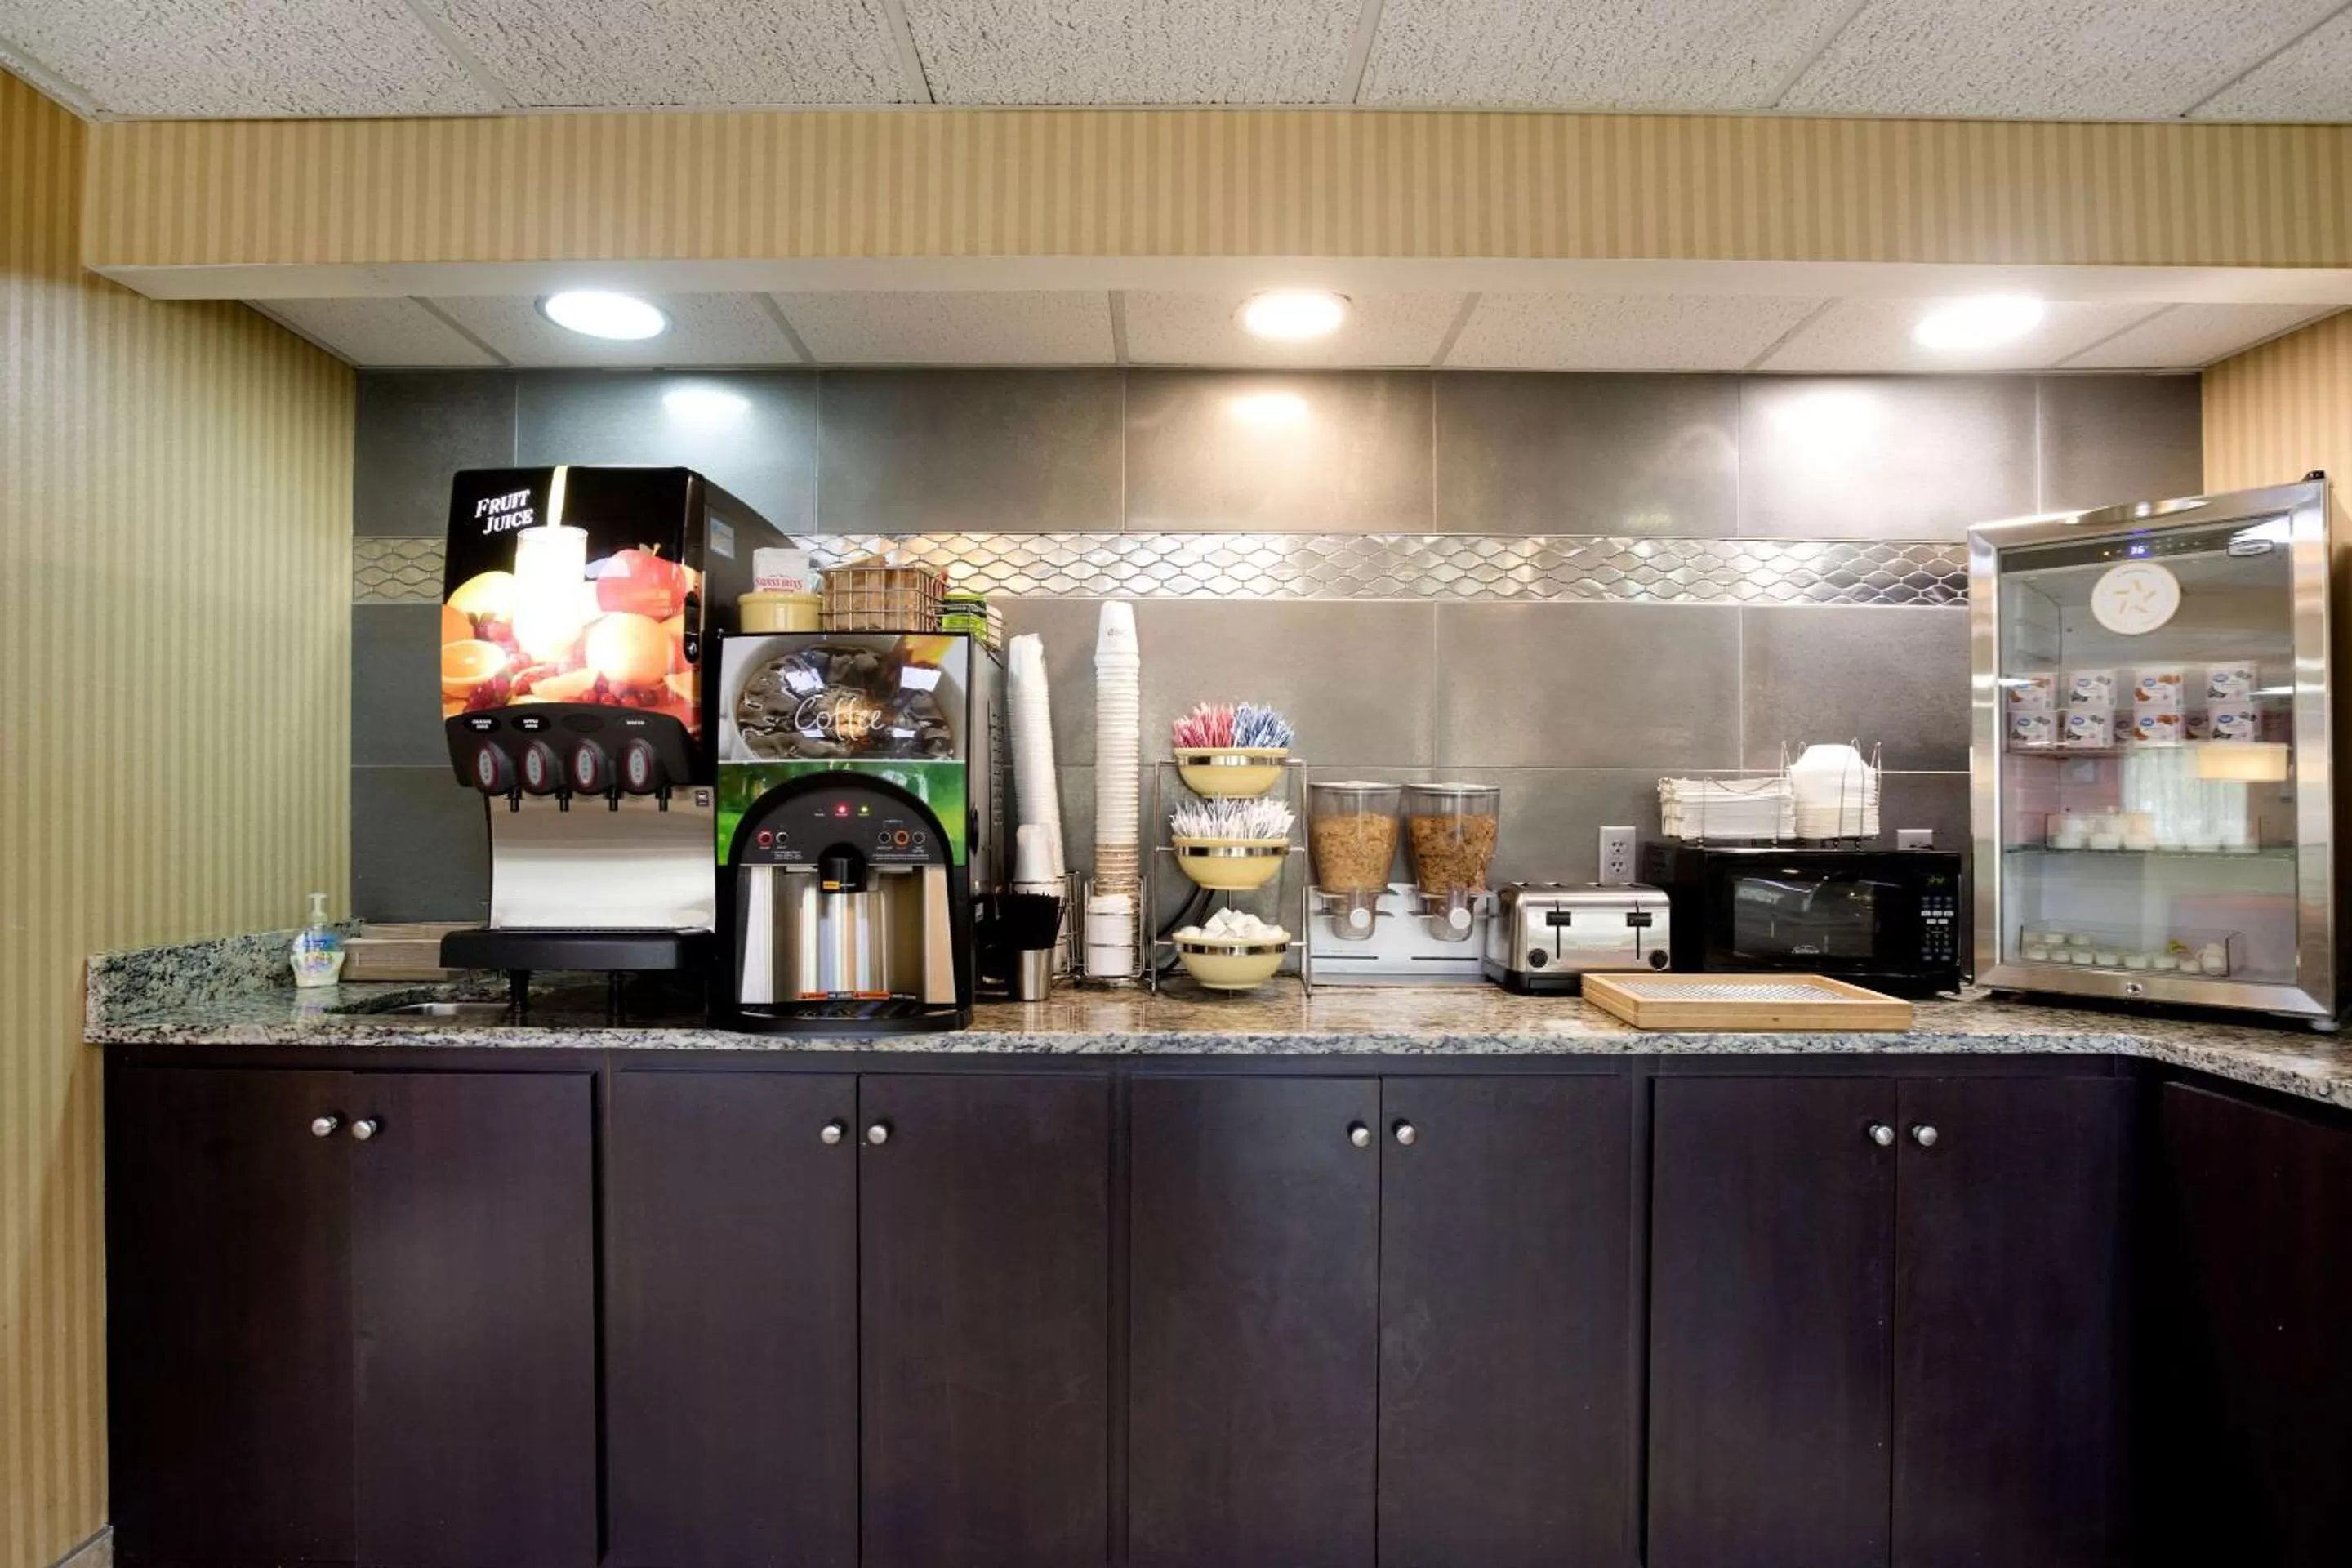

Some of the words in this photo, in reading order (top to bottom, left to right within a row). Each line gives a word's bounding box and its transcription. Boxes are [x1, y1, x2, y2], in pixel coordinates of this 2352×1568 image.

[474, 488, 531, 519] FRUIT
[483, 508, 534, 535] JUICE
[794, 696, 886, 741] Coffee
